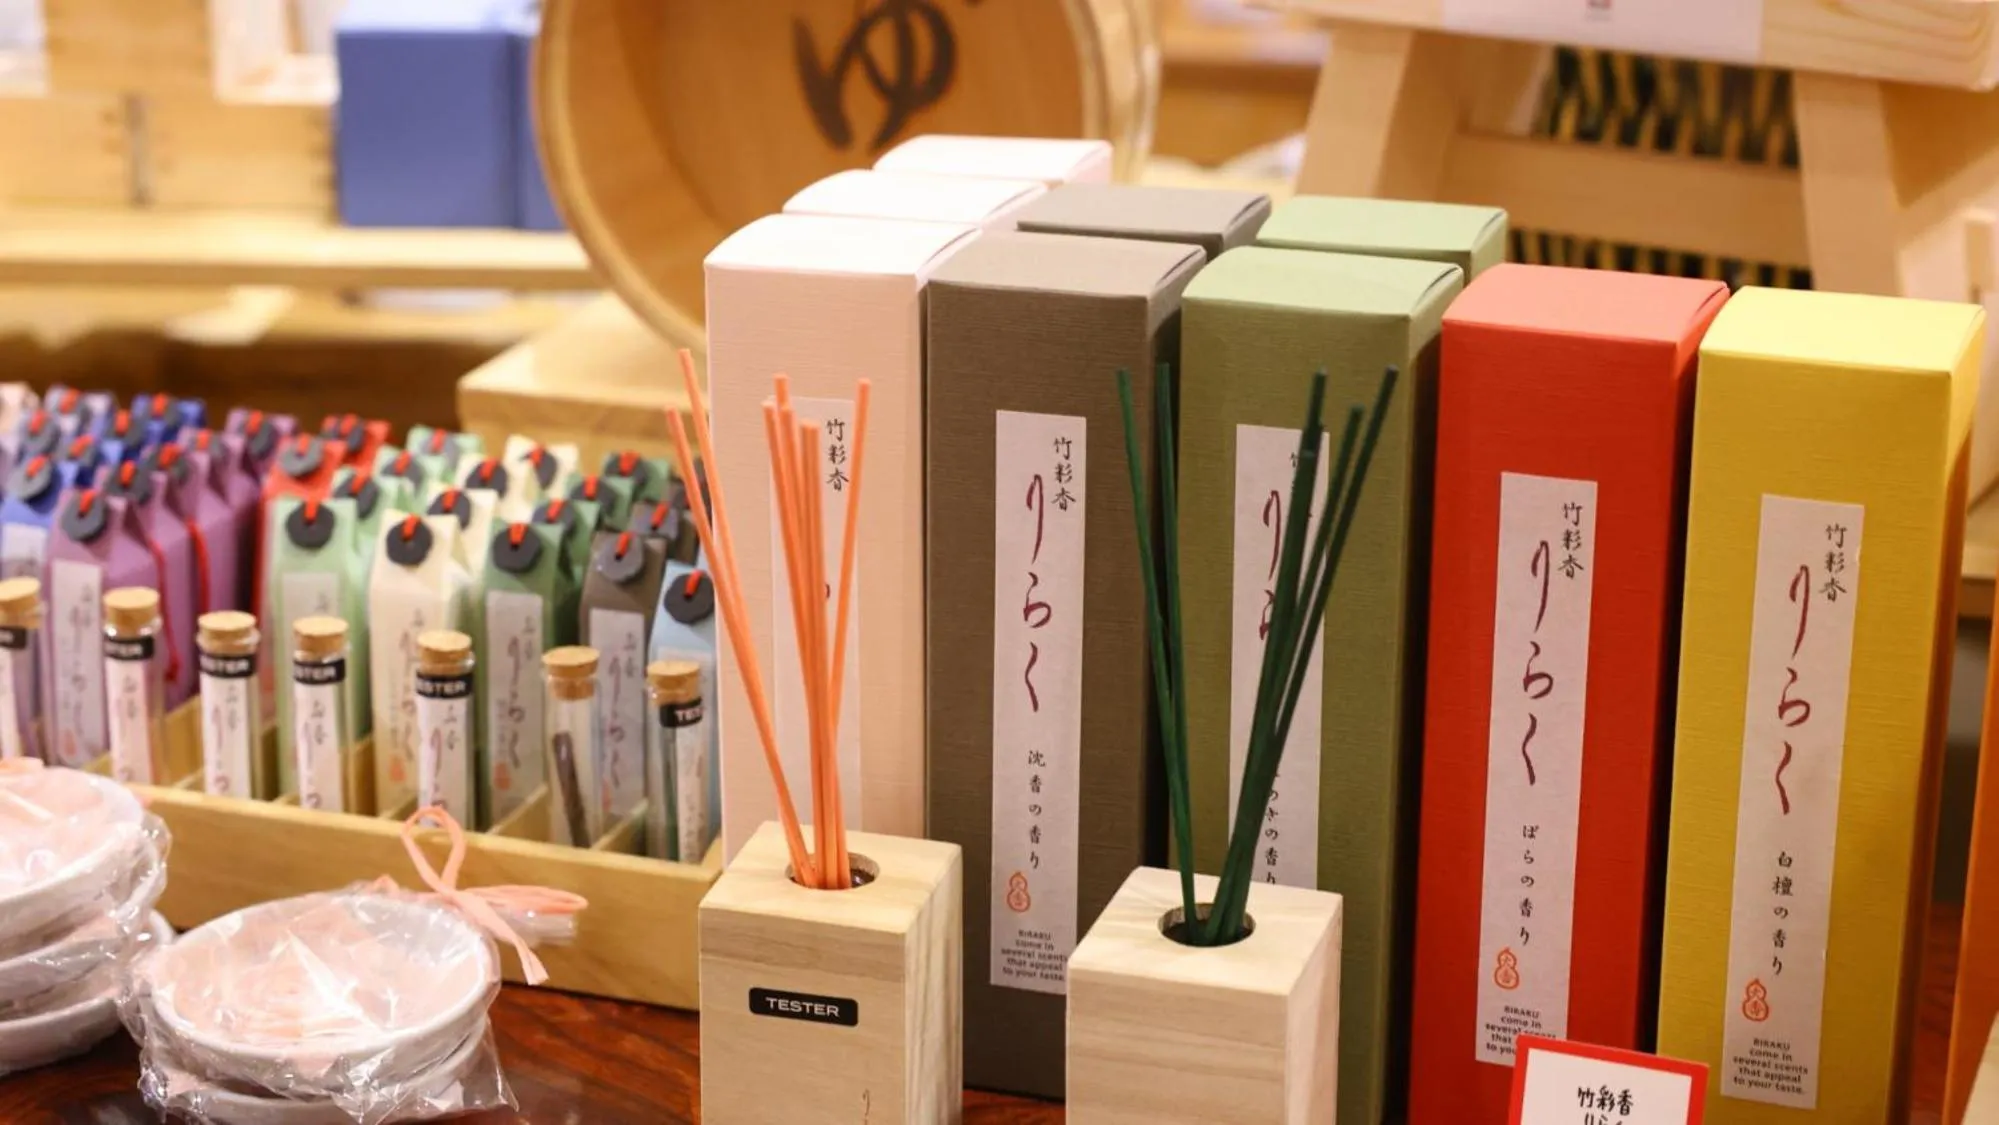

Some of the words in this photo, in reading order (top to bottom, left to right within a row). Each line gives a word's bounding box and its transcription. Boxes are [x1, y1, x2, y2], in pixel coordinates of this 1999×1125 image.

[792, 0, 957, 154] ゆ
[1023, 474, 1051, 712] りらく
[1522, 540, 1554, 786] りらく
[1775, 564, 1811, 815] りらく
[1028, 750, 1046, 869] 沈香の香り
[1520, 825, 1540, 946] ばらの香り
[1772, 851, 1793, 976] 白檀の香り
[765, 996, 840, 1017] TESTER
[1501, 1016, 1528, 1027] come
[1531, 1019, 1542, 1029] in
[1486, 1042, 1497, 1052] to
[1491, 1033, 1512, 1044] that
[1733, 1056, 1771, 1069] several
[1774, 1063, 1808, 1075] scents
[1749, 1048, 1779, 1059] come
[1782, 1052, 1792, 1062] in
[1734, 1076, 1746, 1086] to
[1748, 1079, 1772, 1090] your
[1739, 1066, 1761, 1078] that
[1764, 1071, 1802, 1084] appeal
[1577, 1085, 1634, 1116] 竹彩香
